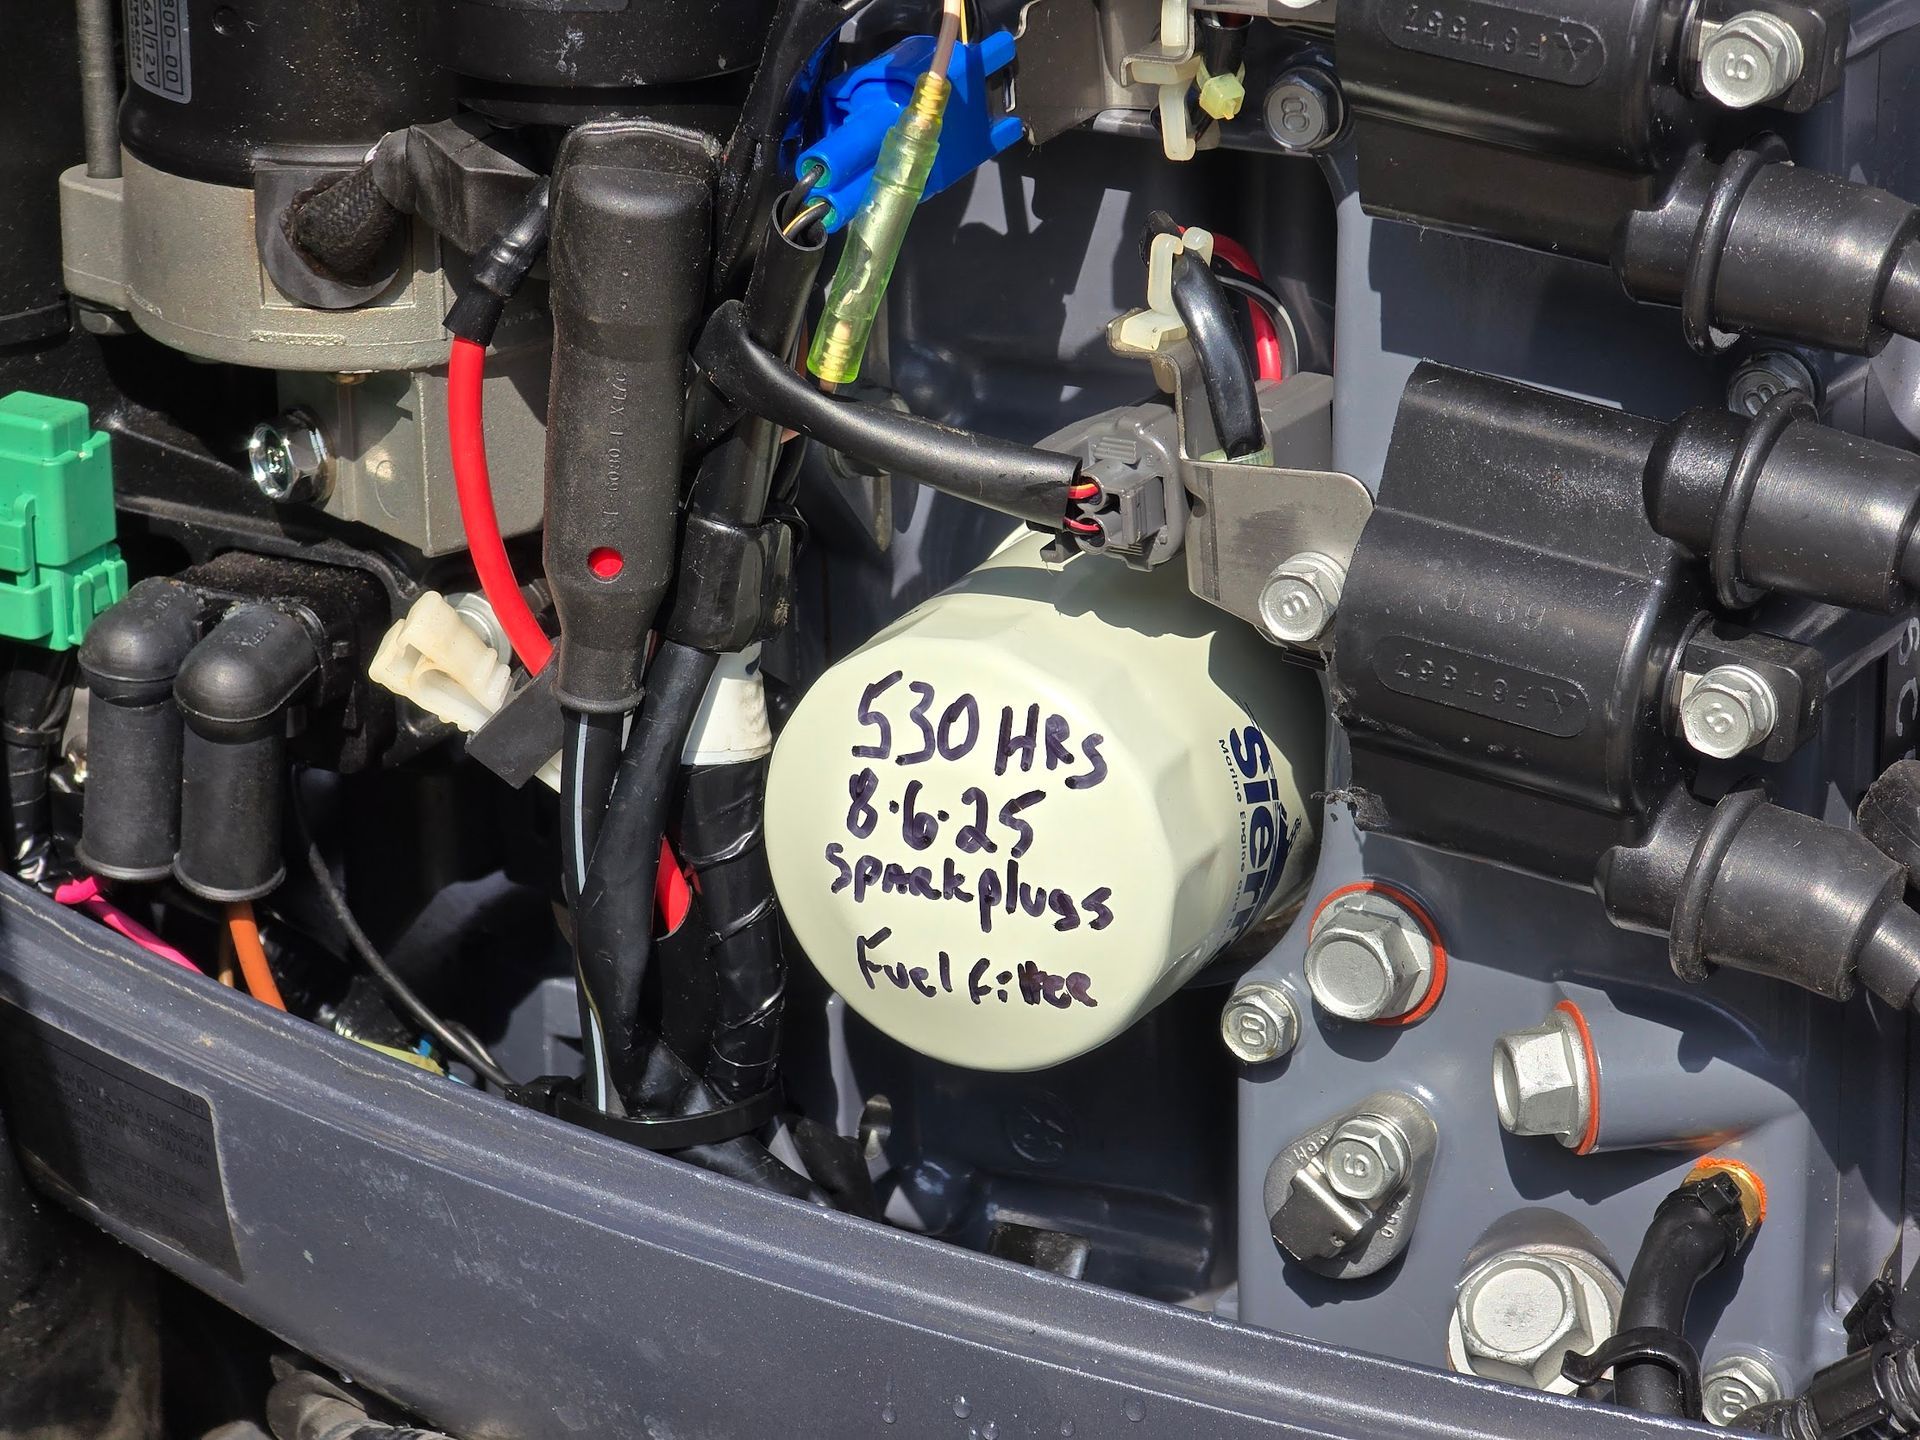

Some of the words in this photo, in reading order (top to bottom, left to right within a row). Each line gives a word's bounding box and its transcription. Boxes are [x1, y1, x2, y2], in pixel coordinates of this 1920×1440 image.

[145, 40, 157, 83] 12V
[851, 670, 980, 766] 530
[1218, 738, 1242, 803] Marine
[856, 926, 954, 998] Fuel
